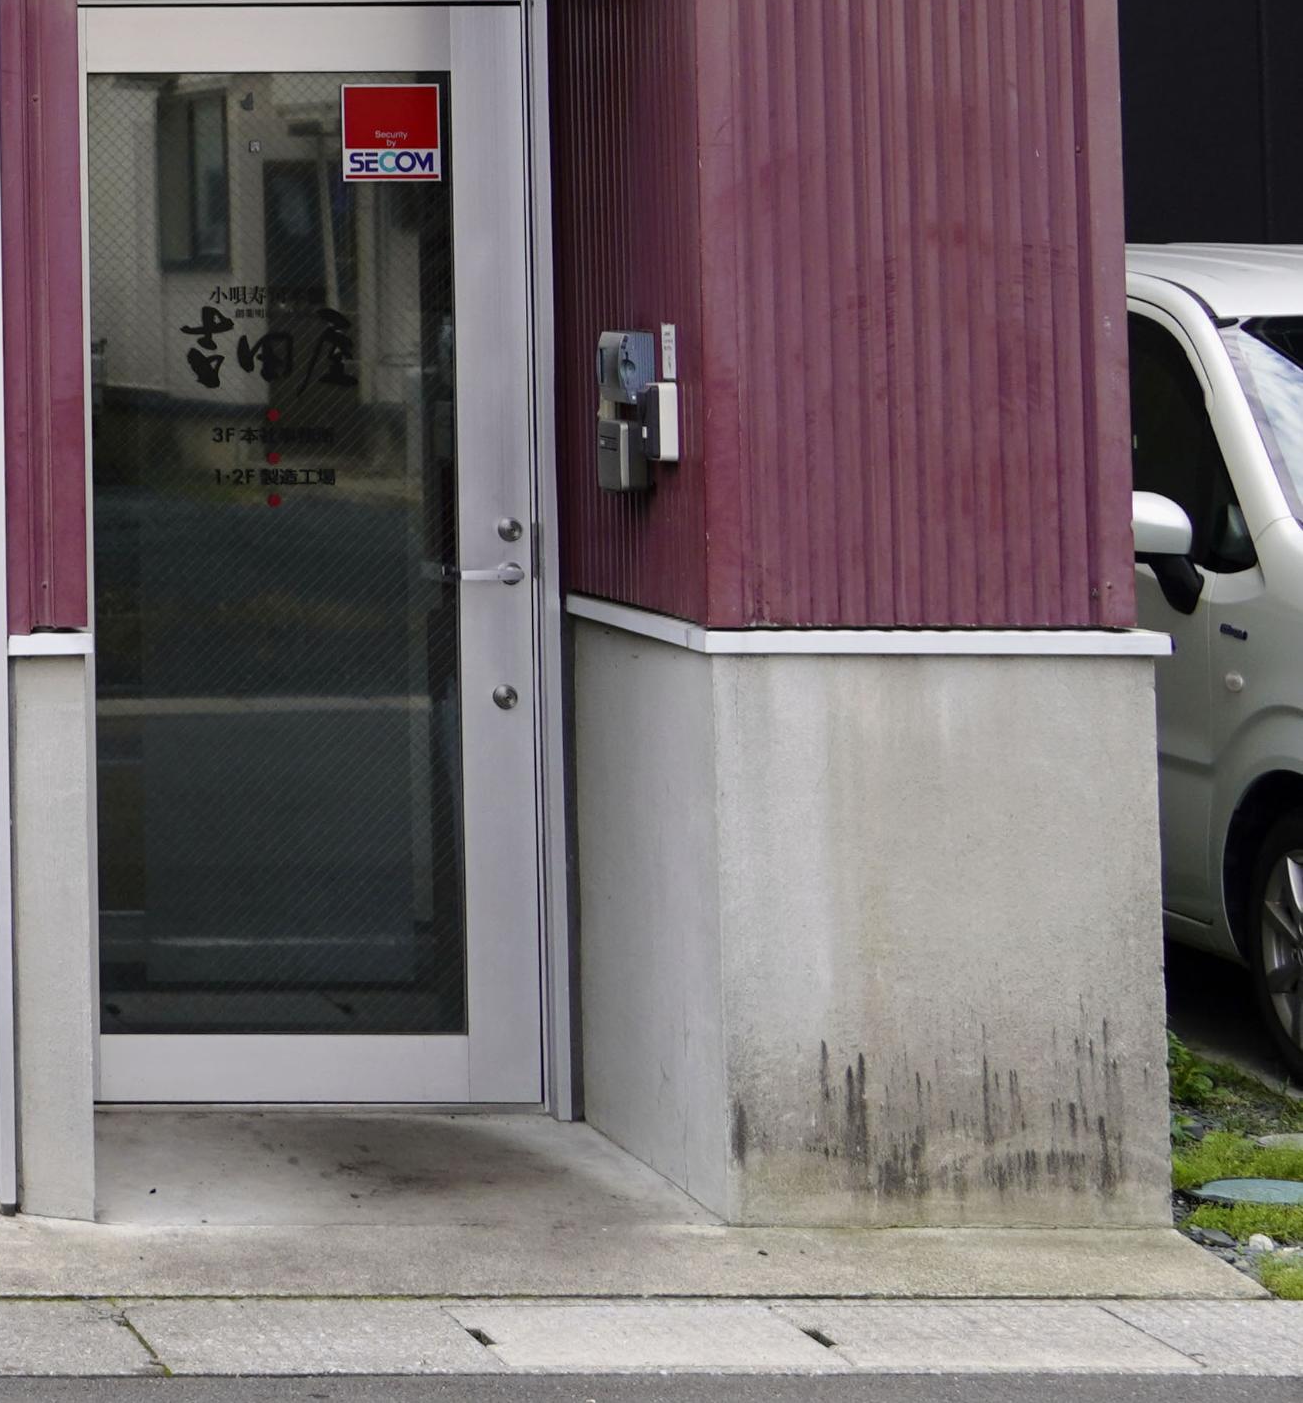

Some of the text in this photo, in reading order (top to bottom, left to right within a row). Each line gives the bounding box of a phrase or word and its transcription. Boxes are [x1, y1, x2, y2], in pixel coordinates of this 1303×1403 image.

[375, 130, 408, 140] Security
[386, 139, 396, 148] by
[349, 150, 434, 173] SECOM
[180, 306, 359, 397] 吉田屋
[212, 427, 235, 443] 3F
